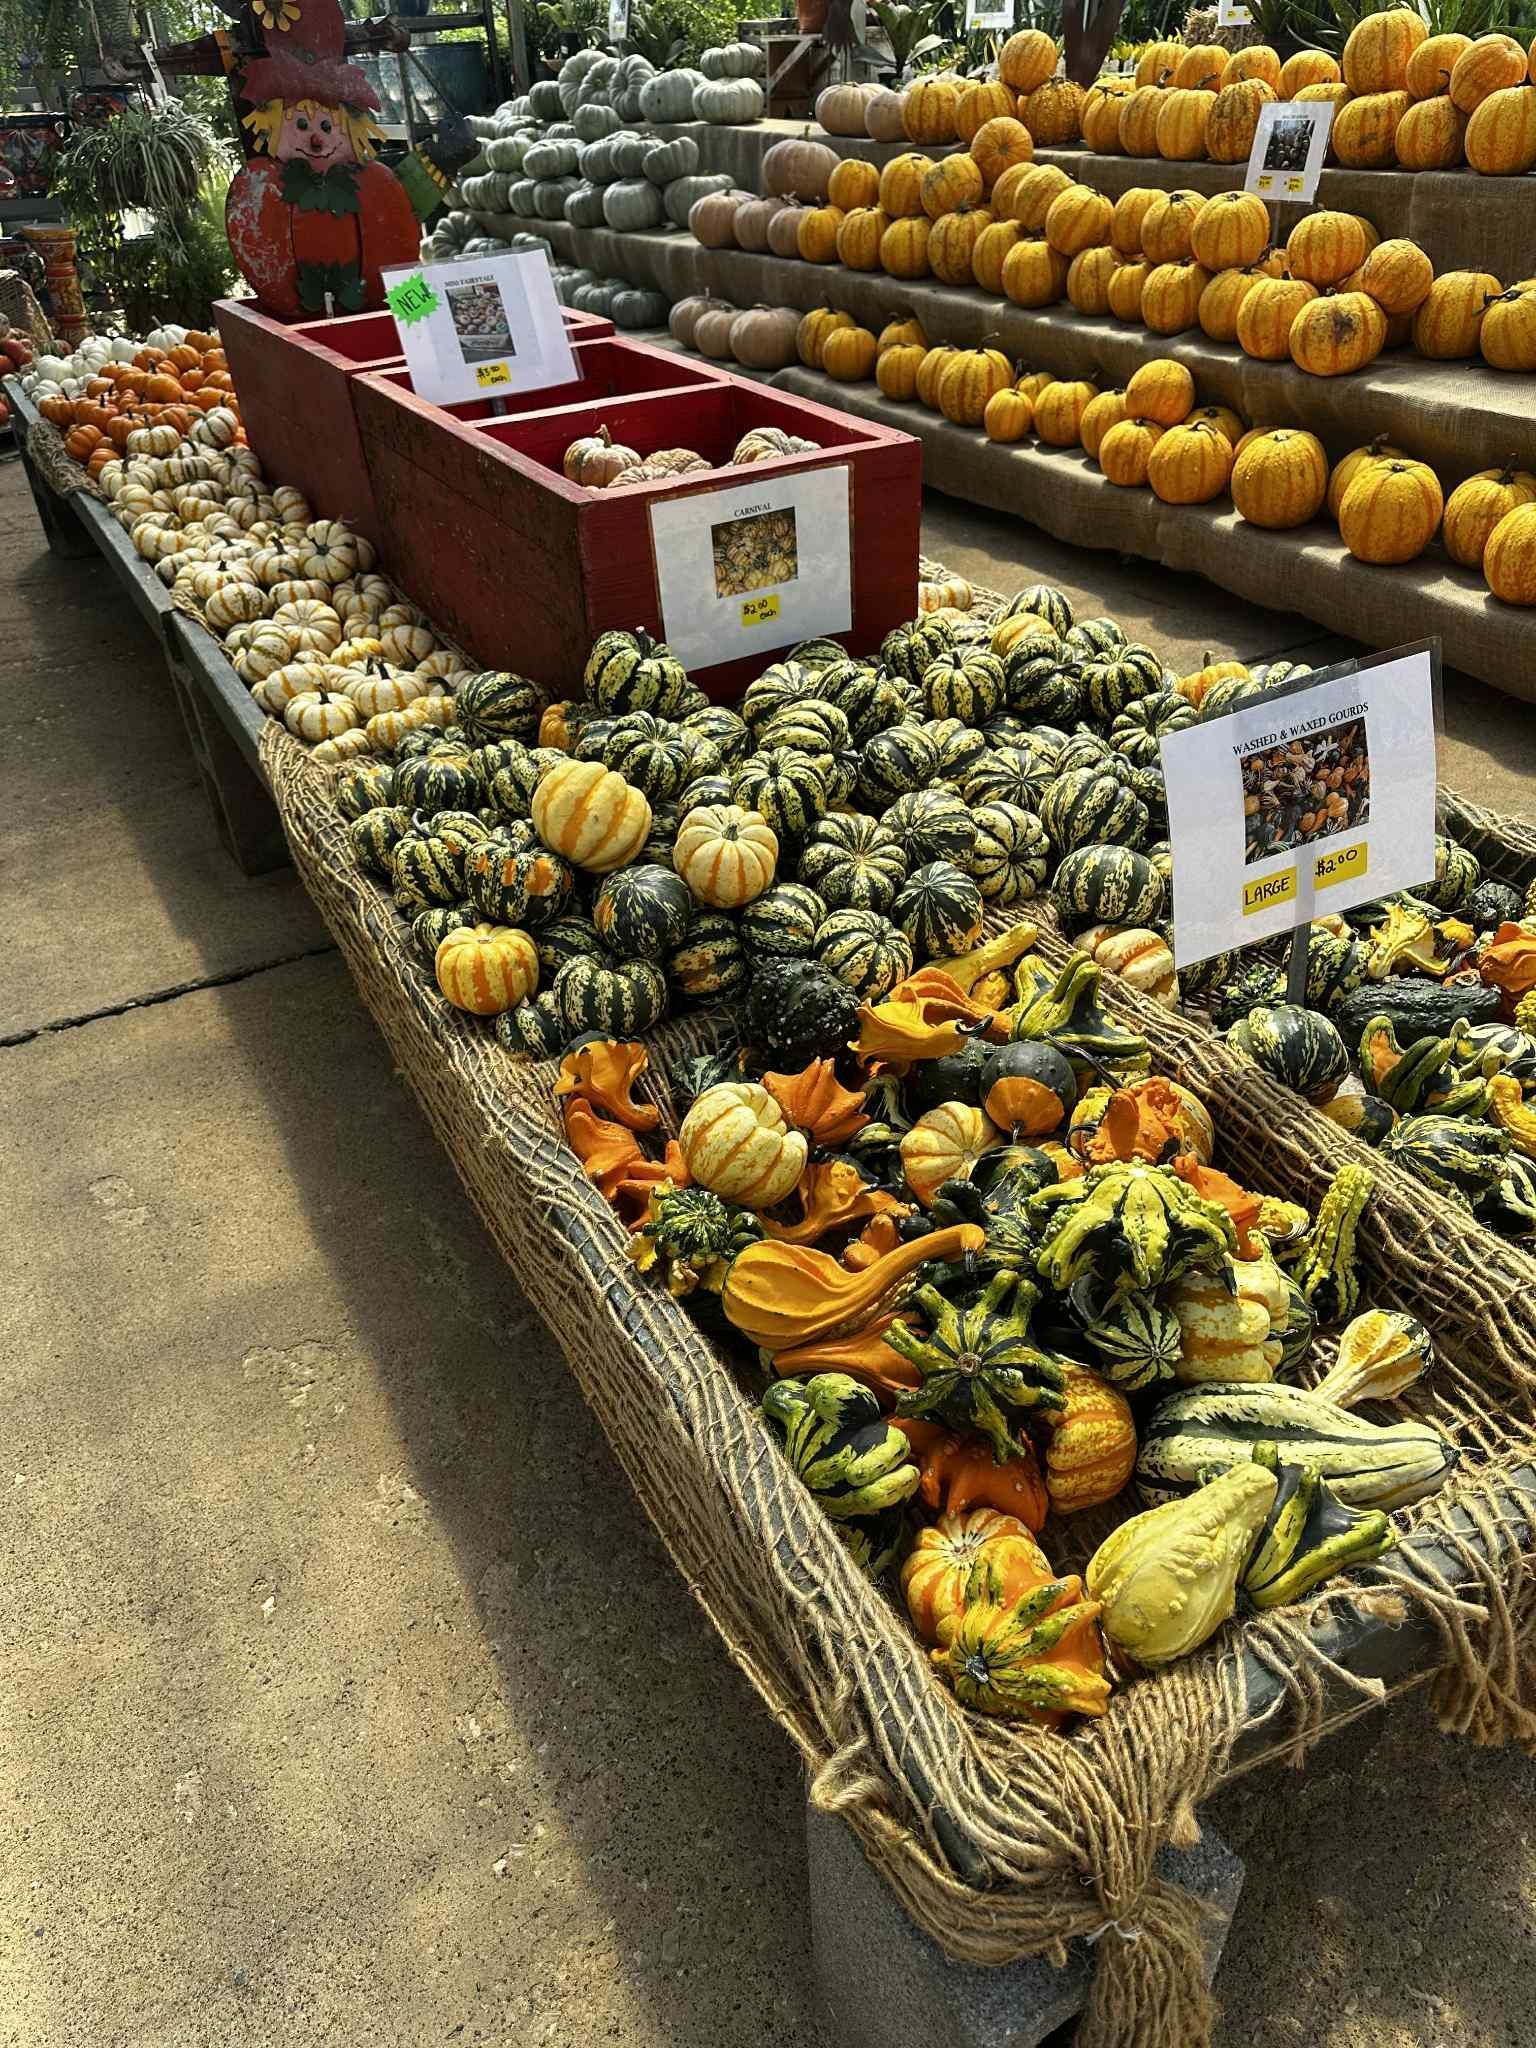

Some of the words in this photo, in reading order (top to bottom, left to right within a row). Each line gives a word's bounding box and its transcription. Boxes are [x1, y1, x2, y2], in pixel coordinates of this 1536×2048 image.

[397, 282, 431, 315] NEW
[734, 503, 772, 517] CARNIVAL
[1232, 733, 1277, 755] WASHED
[1280, 729, 1287, 740] &
[1290, 716, 1326, 737] WAXED
[1328, 701, 1369, 724] GOURDS
[1244, 876, 1290, 906] LARGE
